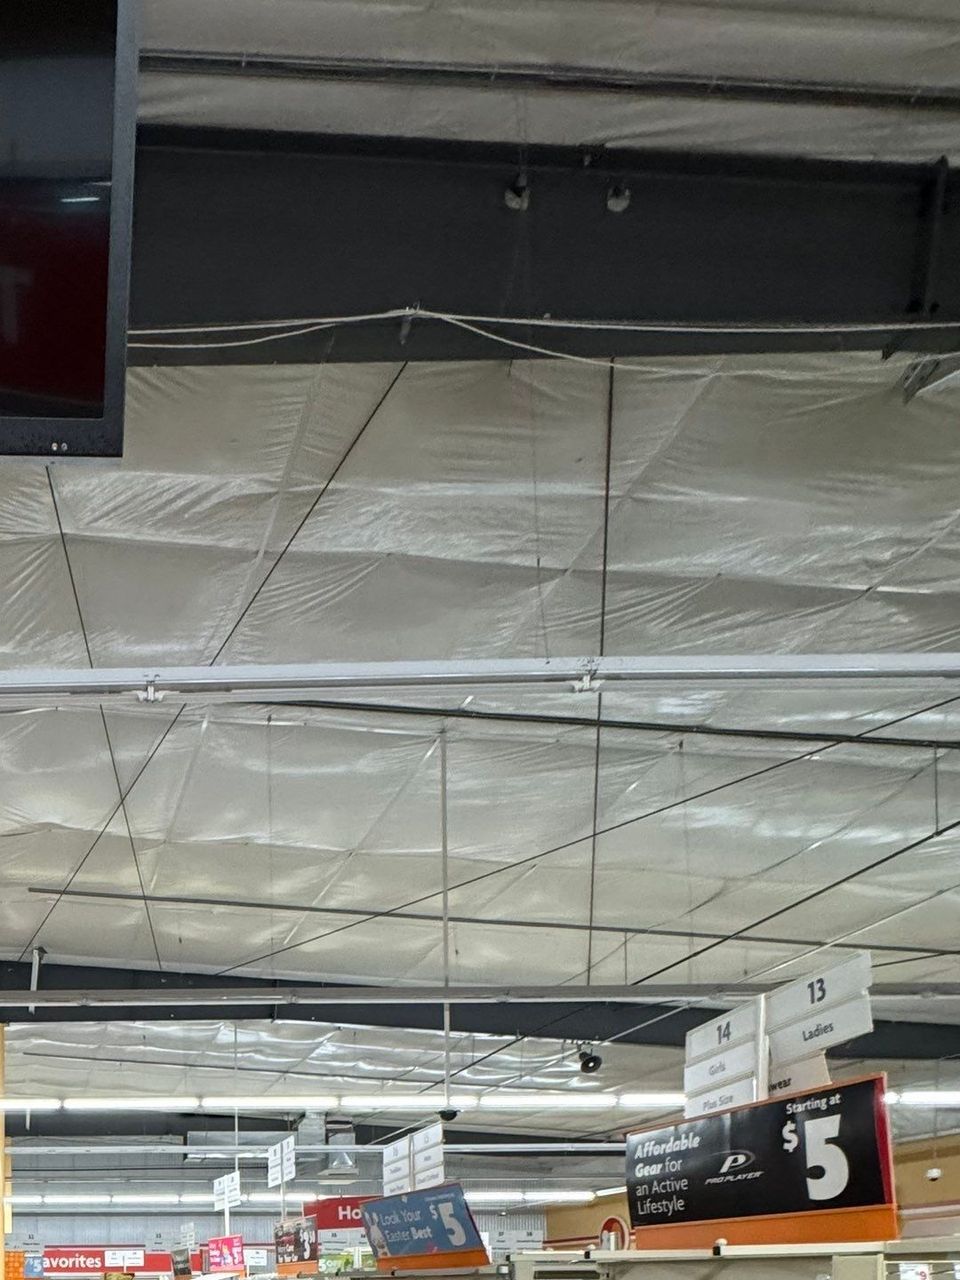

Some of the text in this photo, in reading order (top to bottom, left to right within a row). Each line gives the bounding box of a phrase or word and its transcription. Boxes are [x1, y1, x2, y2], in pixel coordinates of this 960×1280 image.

[807, 978, 827, 1005] 13
[716, 1021, 732, 1045] 14
[802, 1021, 834, 1043] Ladies
[786, 1094, 841, 1115] Starting at
[634, 1132, 700, 1159] Affordable
[782, 1114, 849, 1200] $5
[635, 1158, 683, 1178] Gear for
[636, 1177, 689, 1196] an Active
[338, 1205, 362, 1220] Ho
[379, 1208, 420, 1226] Look Your
[638, 1198, 685, 1216] Lifestyle
[383, 1226, 433, 1242] Easter Best
[429, 1202, 467, 1246] $5
[43, 1252, 102, 1269] avorites
